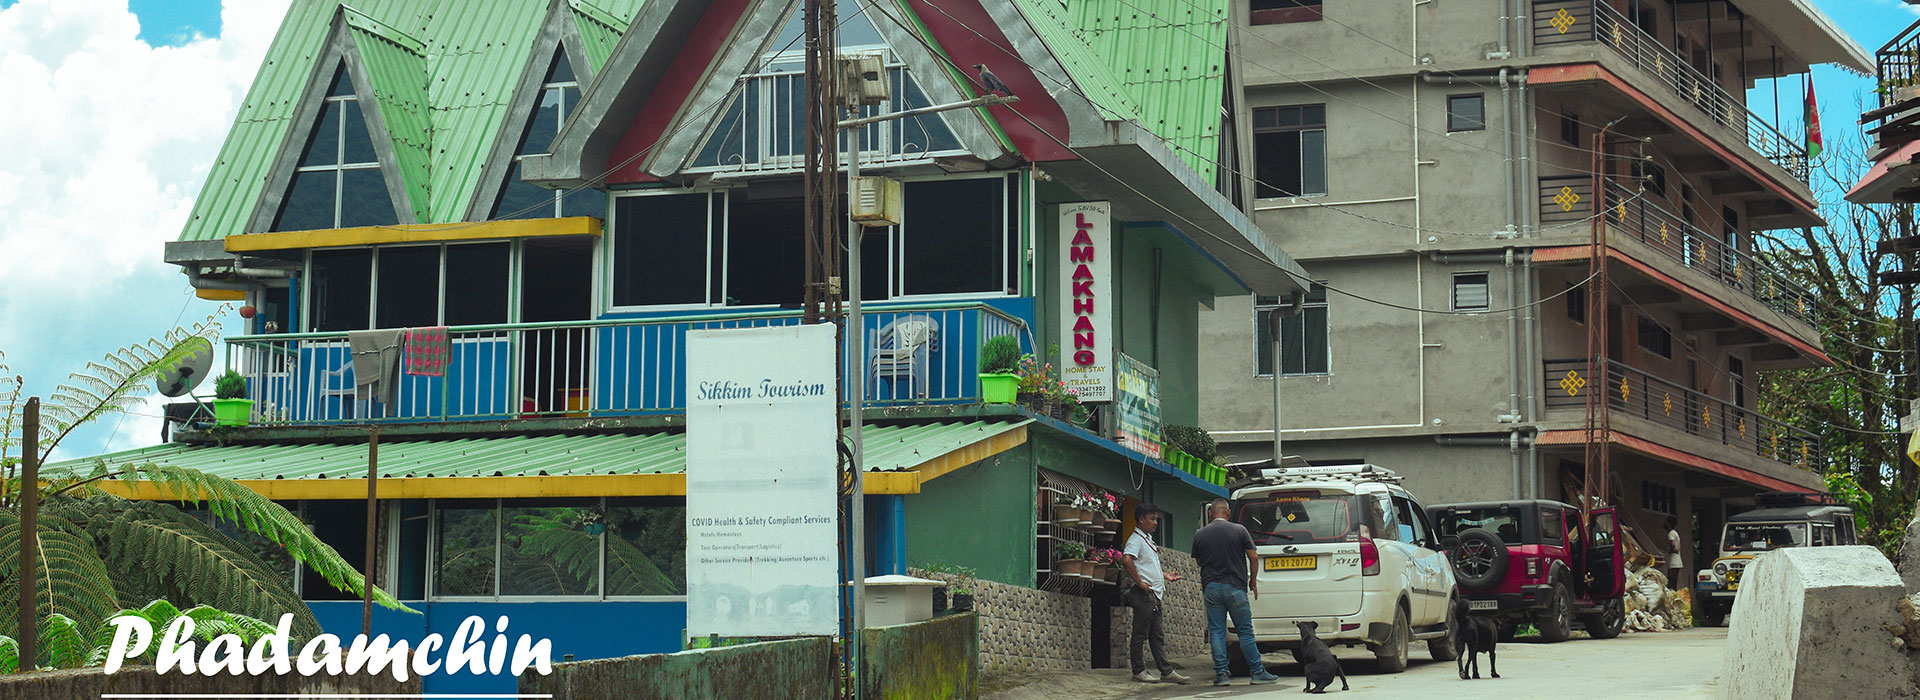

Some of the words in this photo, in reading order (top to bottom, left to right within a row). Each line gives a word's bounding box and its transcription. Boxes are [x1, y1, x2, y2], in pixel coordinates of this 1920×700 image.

[1070, 213, 1095, 366] LAMAKHANG
[1088, 365, 1106, 373] STAY
[697, 380, 752, 400] Sikkim
[757, 378, 825, 399] Tourism
[691, 517, 713, 527] COVID
[714, 517, 737, 527] Health
[738, 517, 743, 526] &
[745, 516, 766, 528] Safety
[768, 515, 803, 528] Compliant
[803, 514, 831, 525] Services
[1271, 559, 1279, 568] SK
